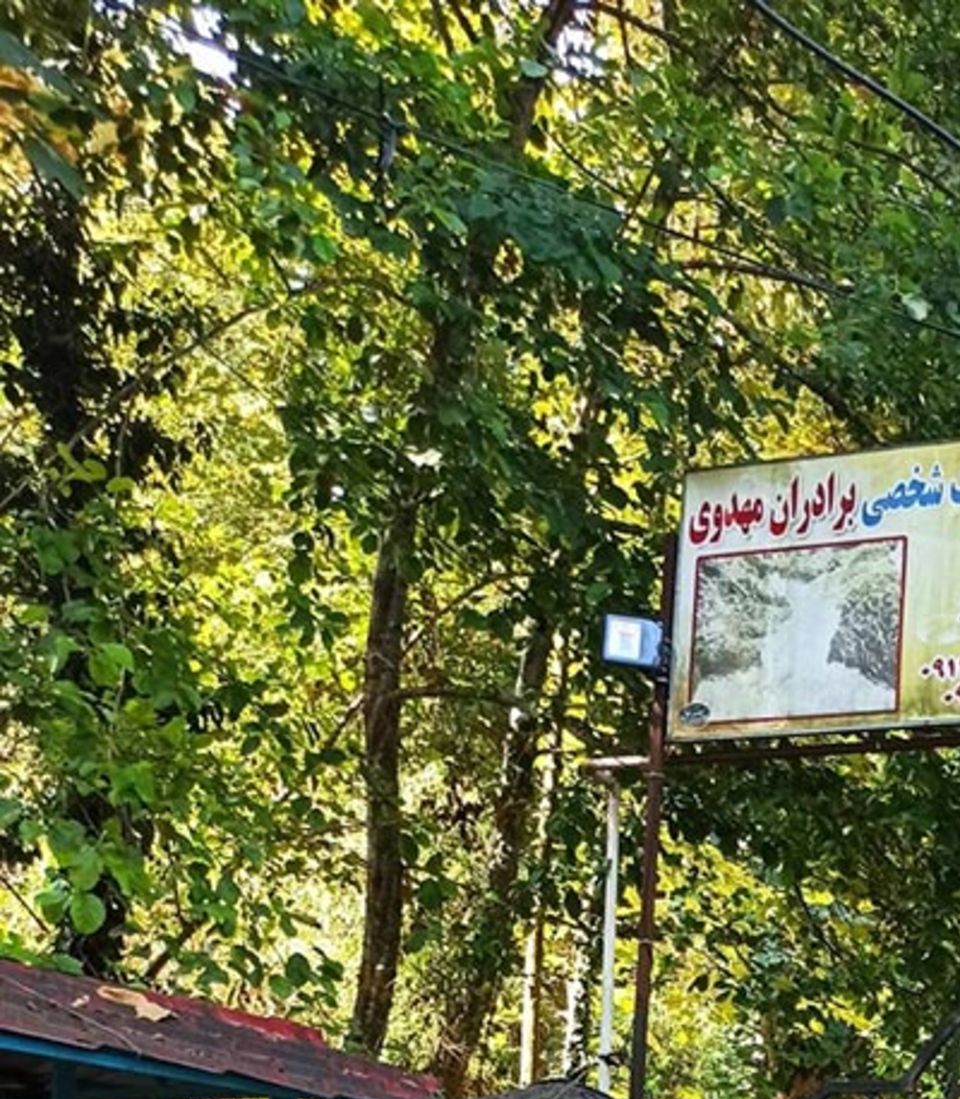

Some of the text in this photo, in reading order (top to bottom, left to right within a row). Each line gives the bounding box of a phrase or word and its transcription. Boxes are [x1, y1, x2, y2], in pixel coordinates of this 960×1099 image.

[688, 494, 765, 545] مهدوی
[768, 471, 856, 535] برادران
[861, 464, 943, 526] شخصی
